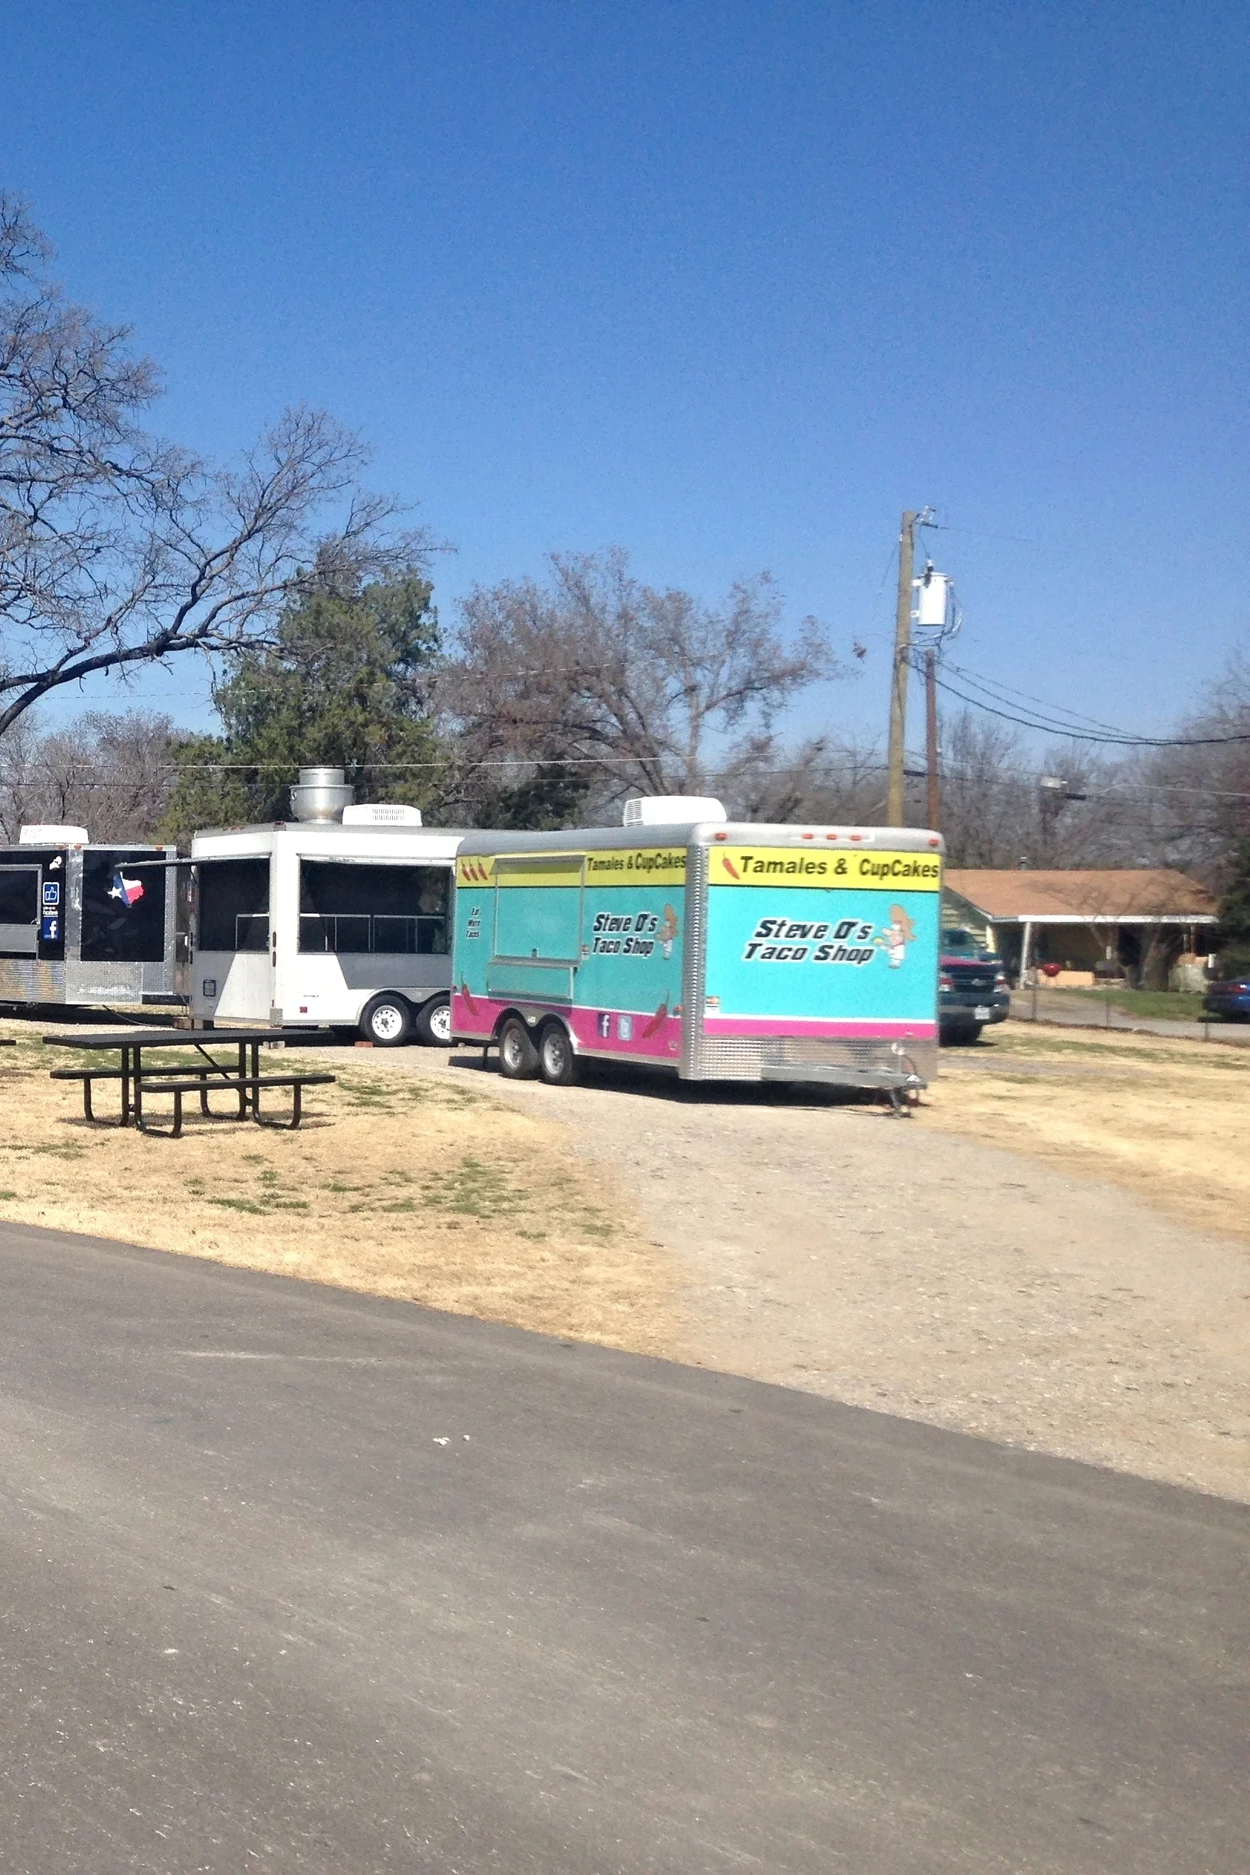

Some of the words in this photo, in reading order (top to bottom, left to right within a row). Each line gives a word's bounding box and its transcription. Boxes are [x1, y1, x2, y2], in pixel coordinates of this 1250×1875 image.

[587, 857, 624, 871] Tamales
[627, 856, 633, 870] &
[635, 853, 686, 873] CupCakes
[741, 856, 827, 875] Tamales
[834, 858, 848, 875] &
[859, 858, 939, 880] CupCakes
[593, 913, 632, 932] Steve
[754, 919, 829, 939] Steve
[592, 937, 621, 954] Taco
[623, 937, 655, 957] Shop
[744, 942, 807, 960] Taco
[813, 944, 874, 964] Shop
